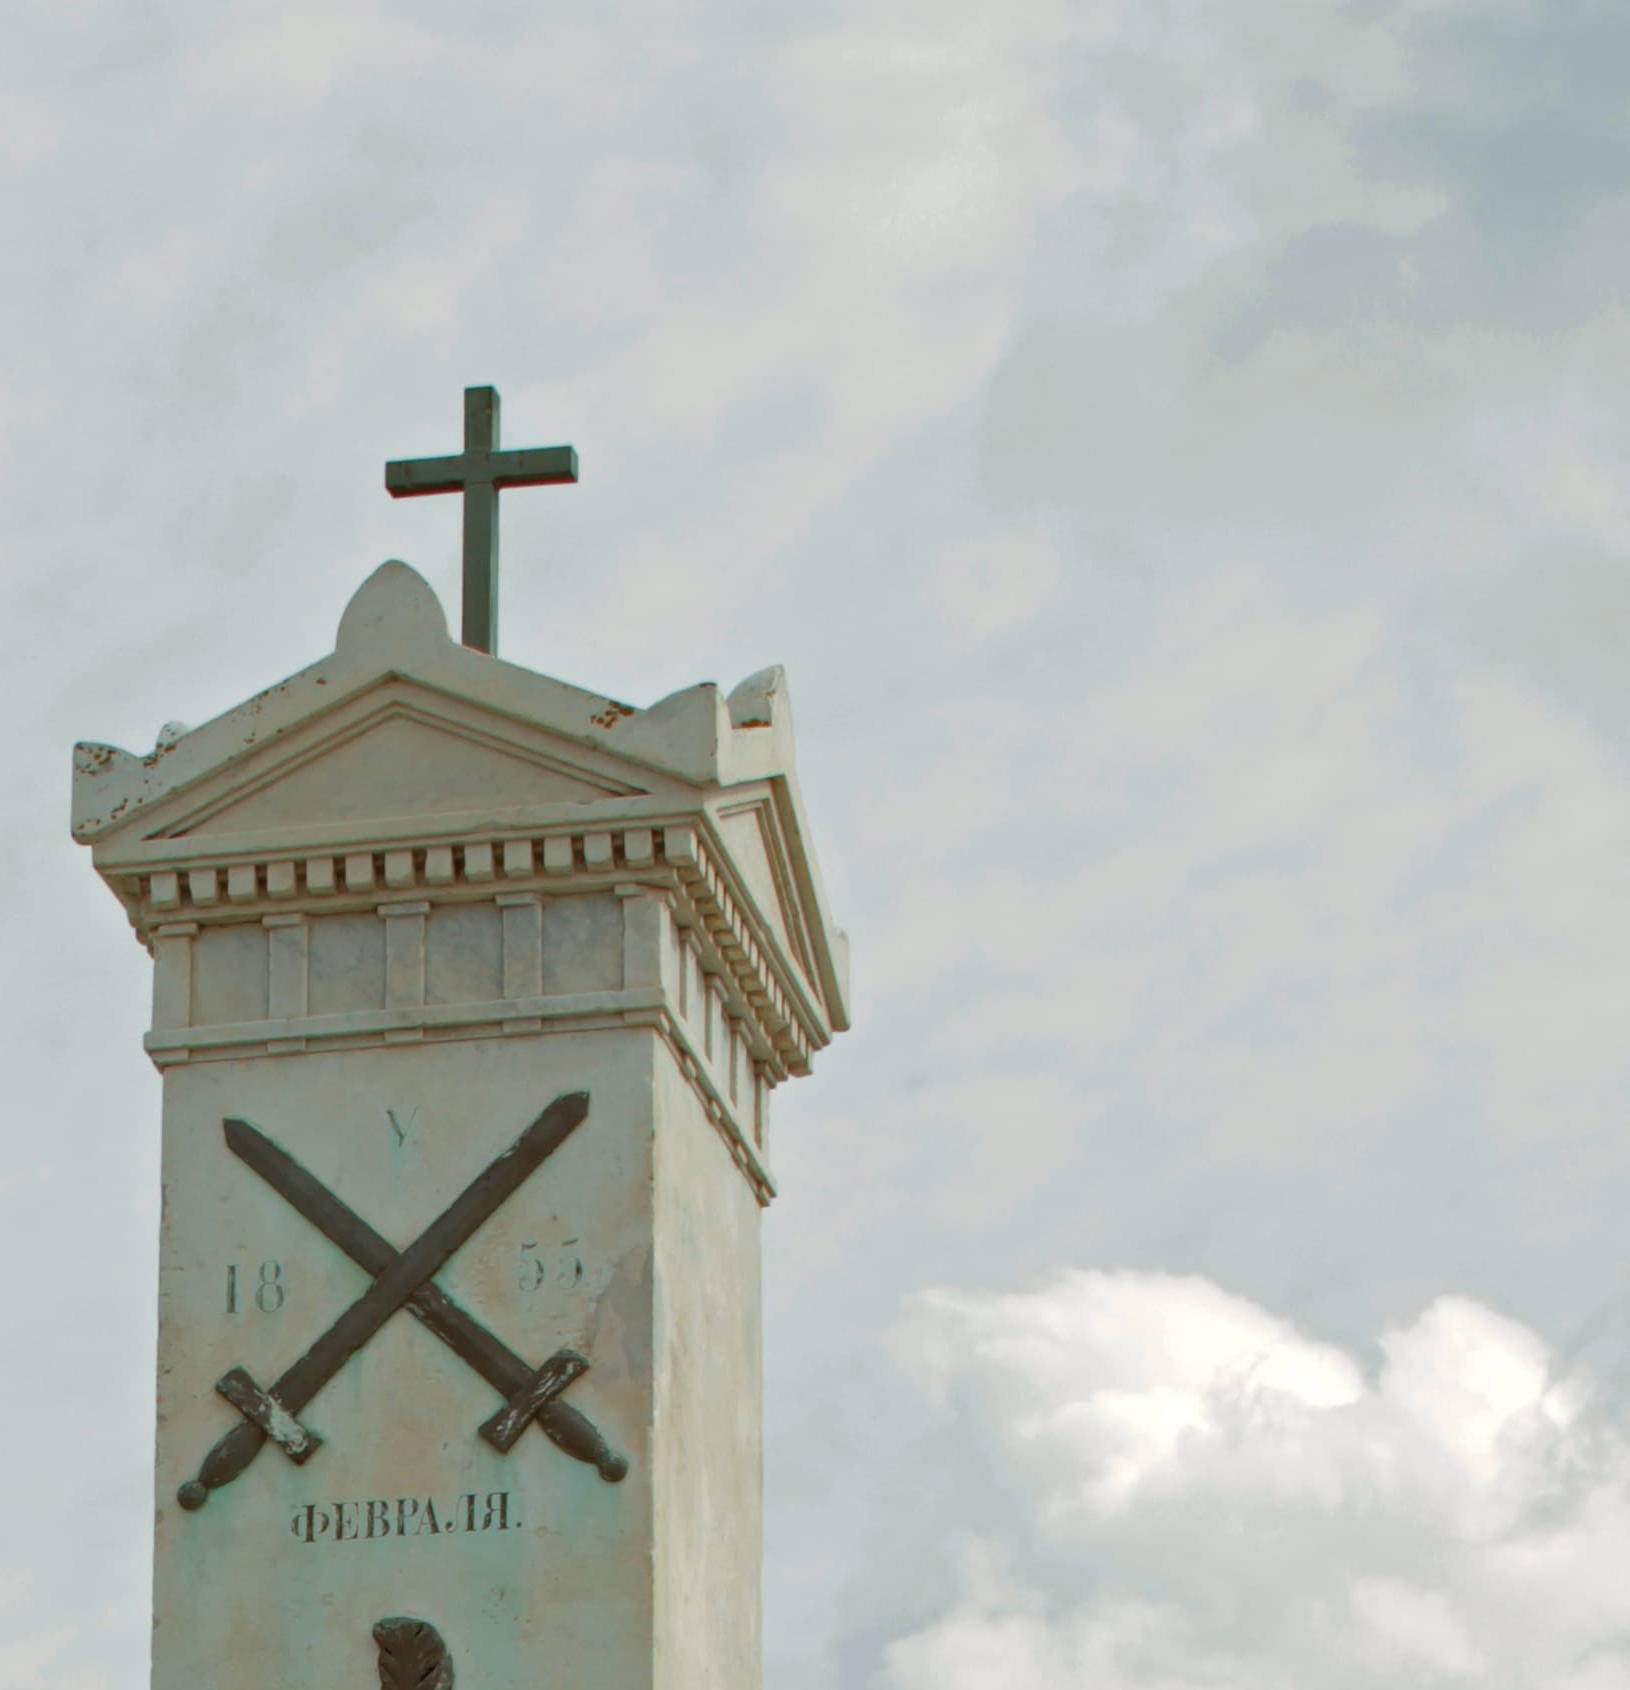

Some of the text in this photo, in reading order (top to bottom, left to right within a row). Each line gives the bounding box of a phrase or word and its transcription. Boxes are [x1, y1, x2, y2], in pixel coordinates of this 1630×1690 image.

[223, 1238, 584, 1315] 18 55
[290, 1491, 523, 1544] ФЕВРАЛЯ.
